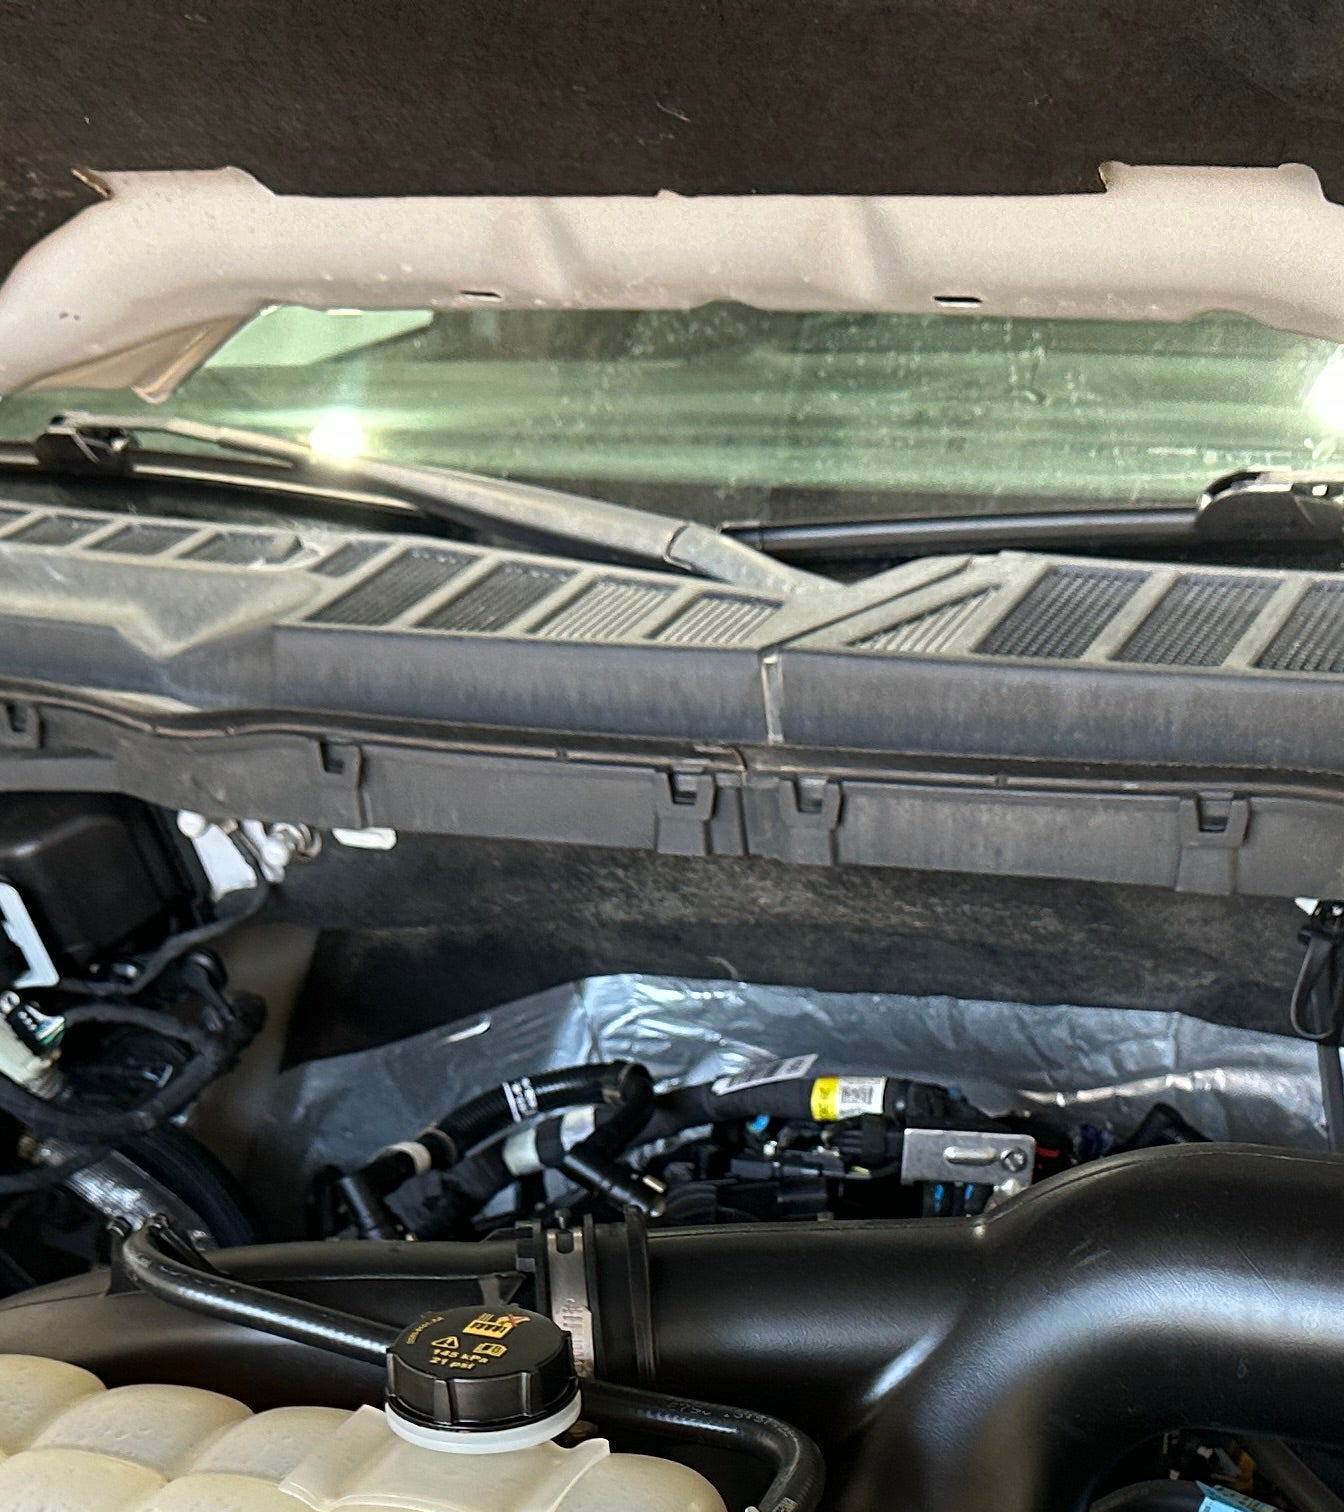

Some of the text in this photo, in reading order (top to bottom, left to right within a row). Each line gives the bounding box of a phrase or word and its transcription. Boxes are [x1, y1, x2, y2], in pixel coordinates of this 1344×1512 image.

[429, 1356, 475, 1370] 21 psi
[433, 1349, 489, 1364] 145 kPa
